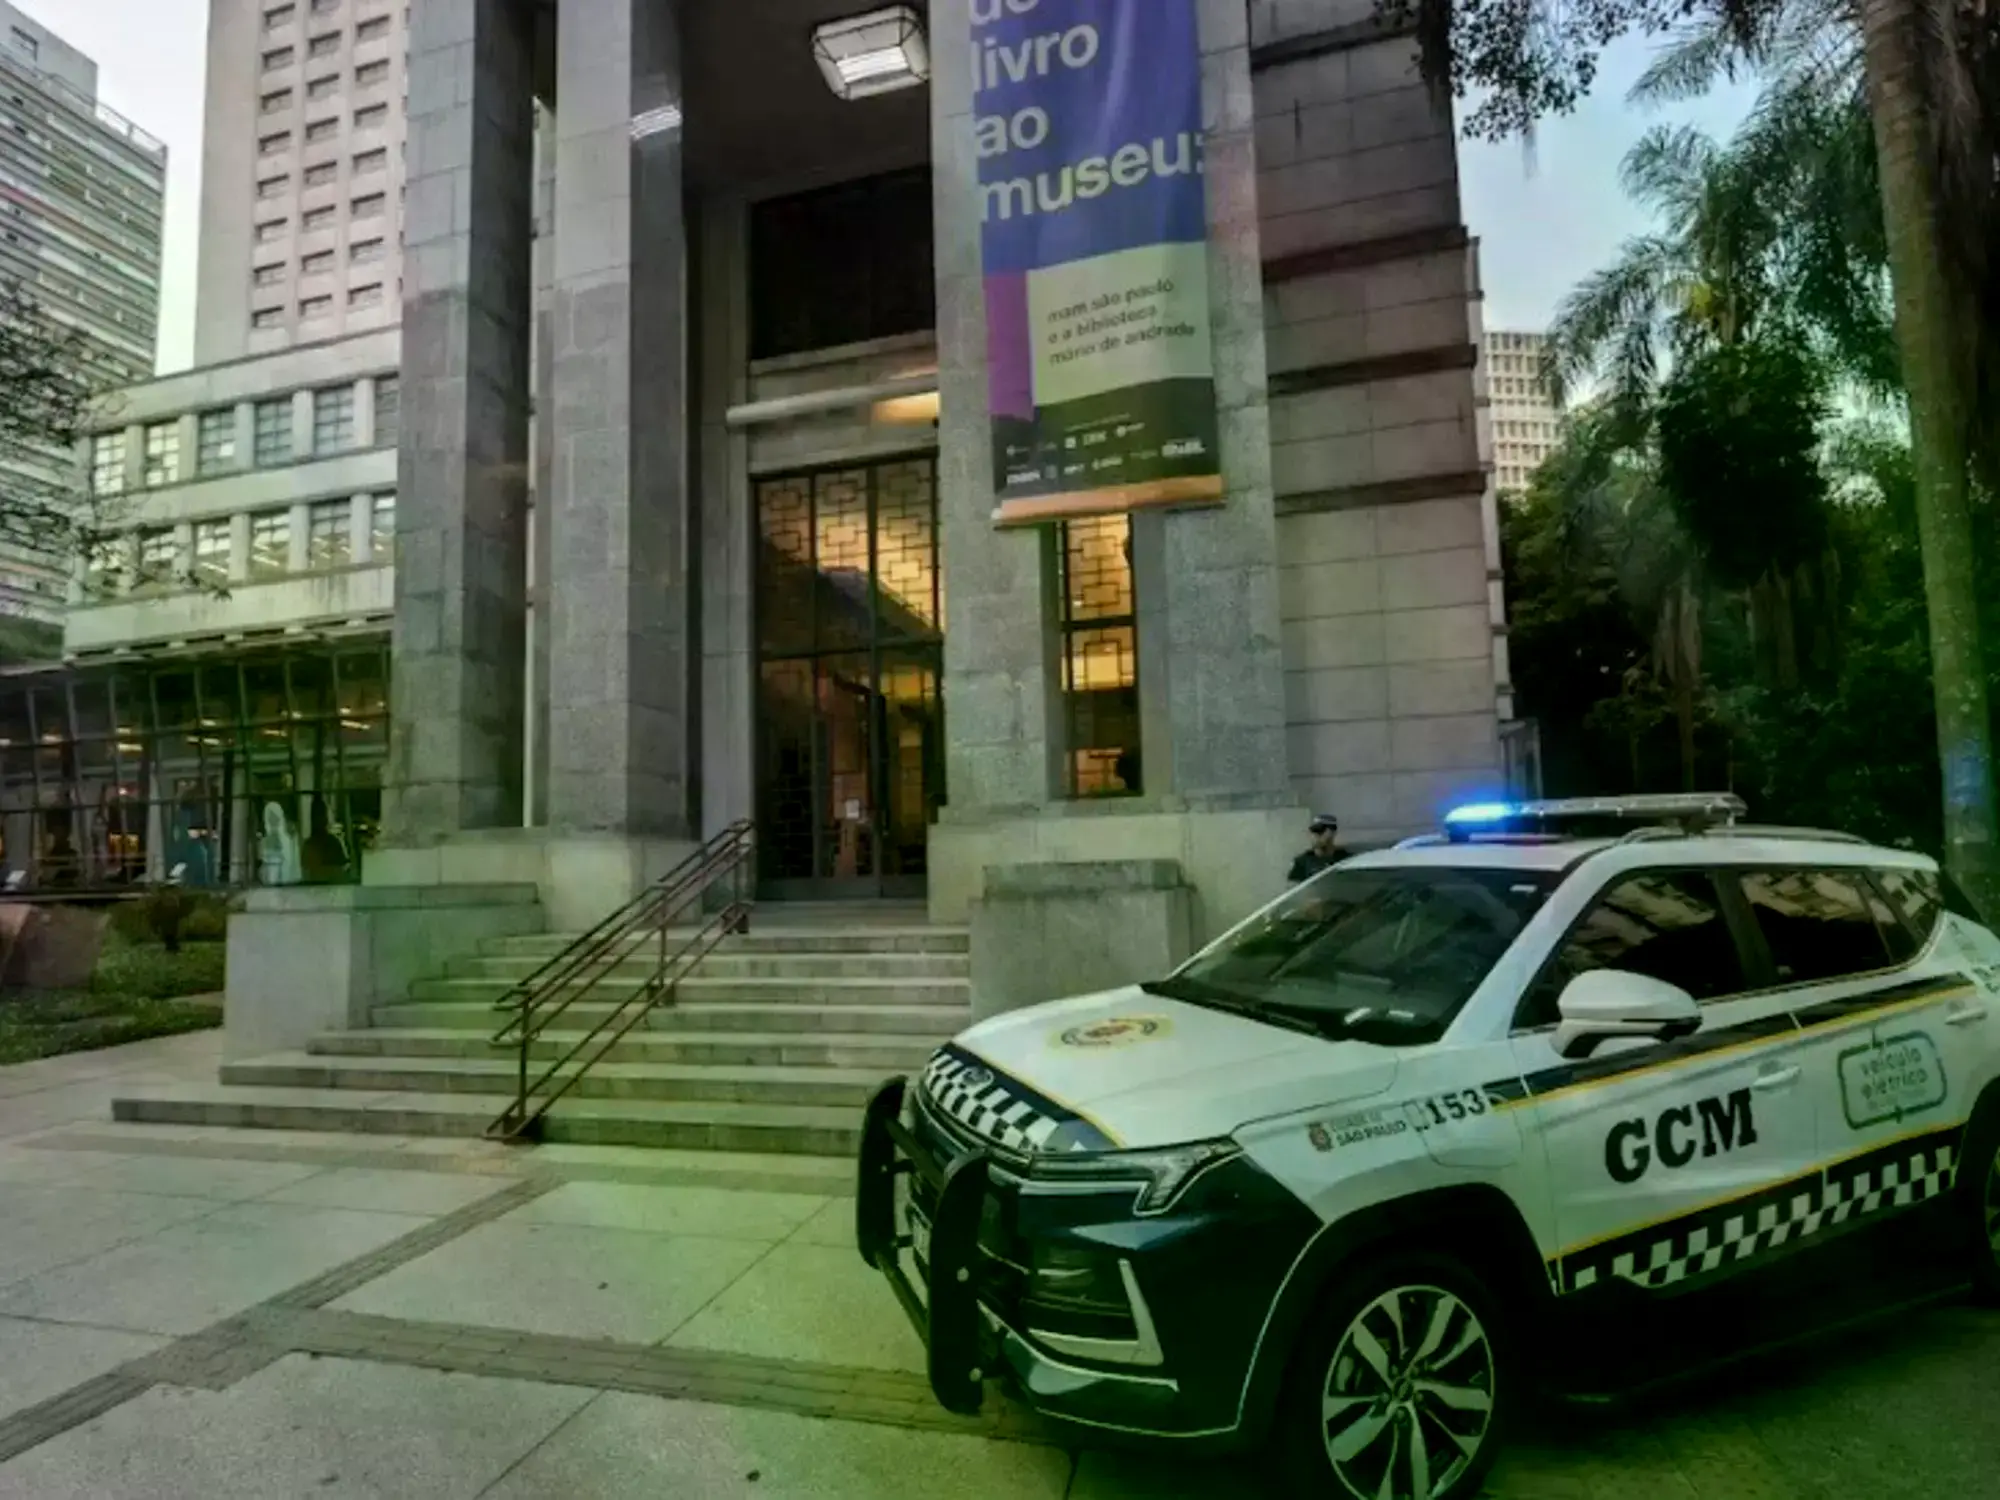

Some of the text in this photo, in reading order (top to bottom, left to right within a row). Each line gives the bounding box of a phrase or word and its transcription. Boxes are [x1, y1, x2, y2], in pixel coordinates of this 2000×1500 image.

[970, 24, 1098, 92] livro
[975, 106, 1049, 158] ao
[1048, 302, 1088, 323] mam
[1048, 304, 1157, 344] e a biblioteca
[1100, 336, 1121, 352] de
[1124, 321, 1195, 345] andrade
[1425, 1088, 1486, 1125] 153
[1604, 1087, 1757, 1184] GCM
